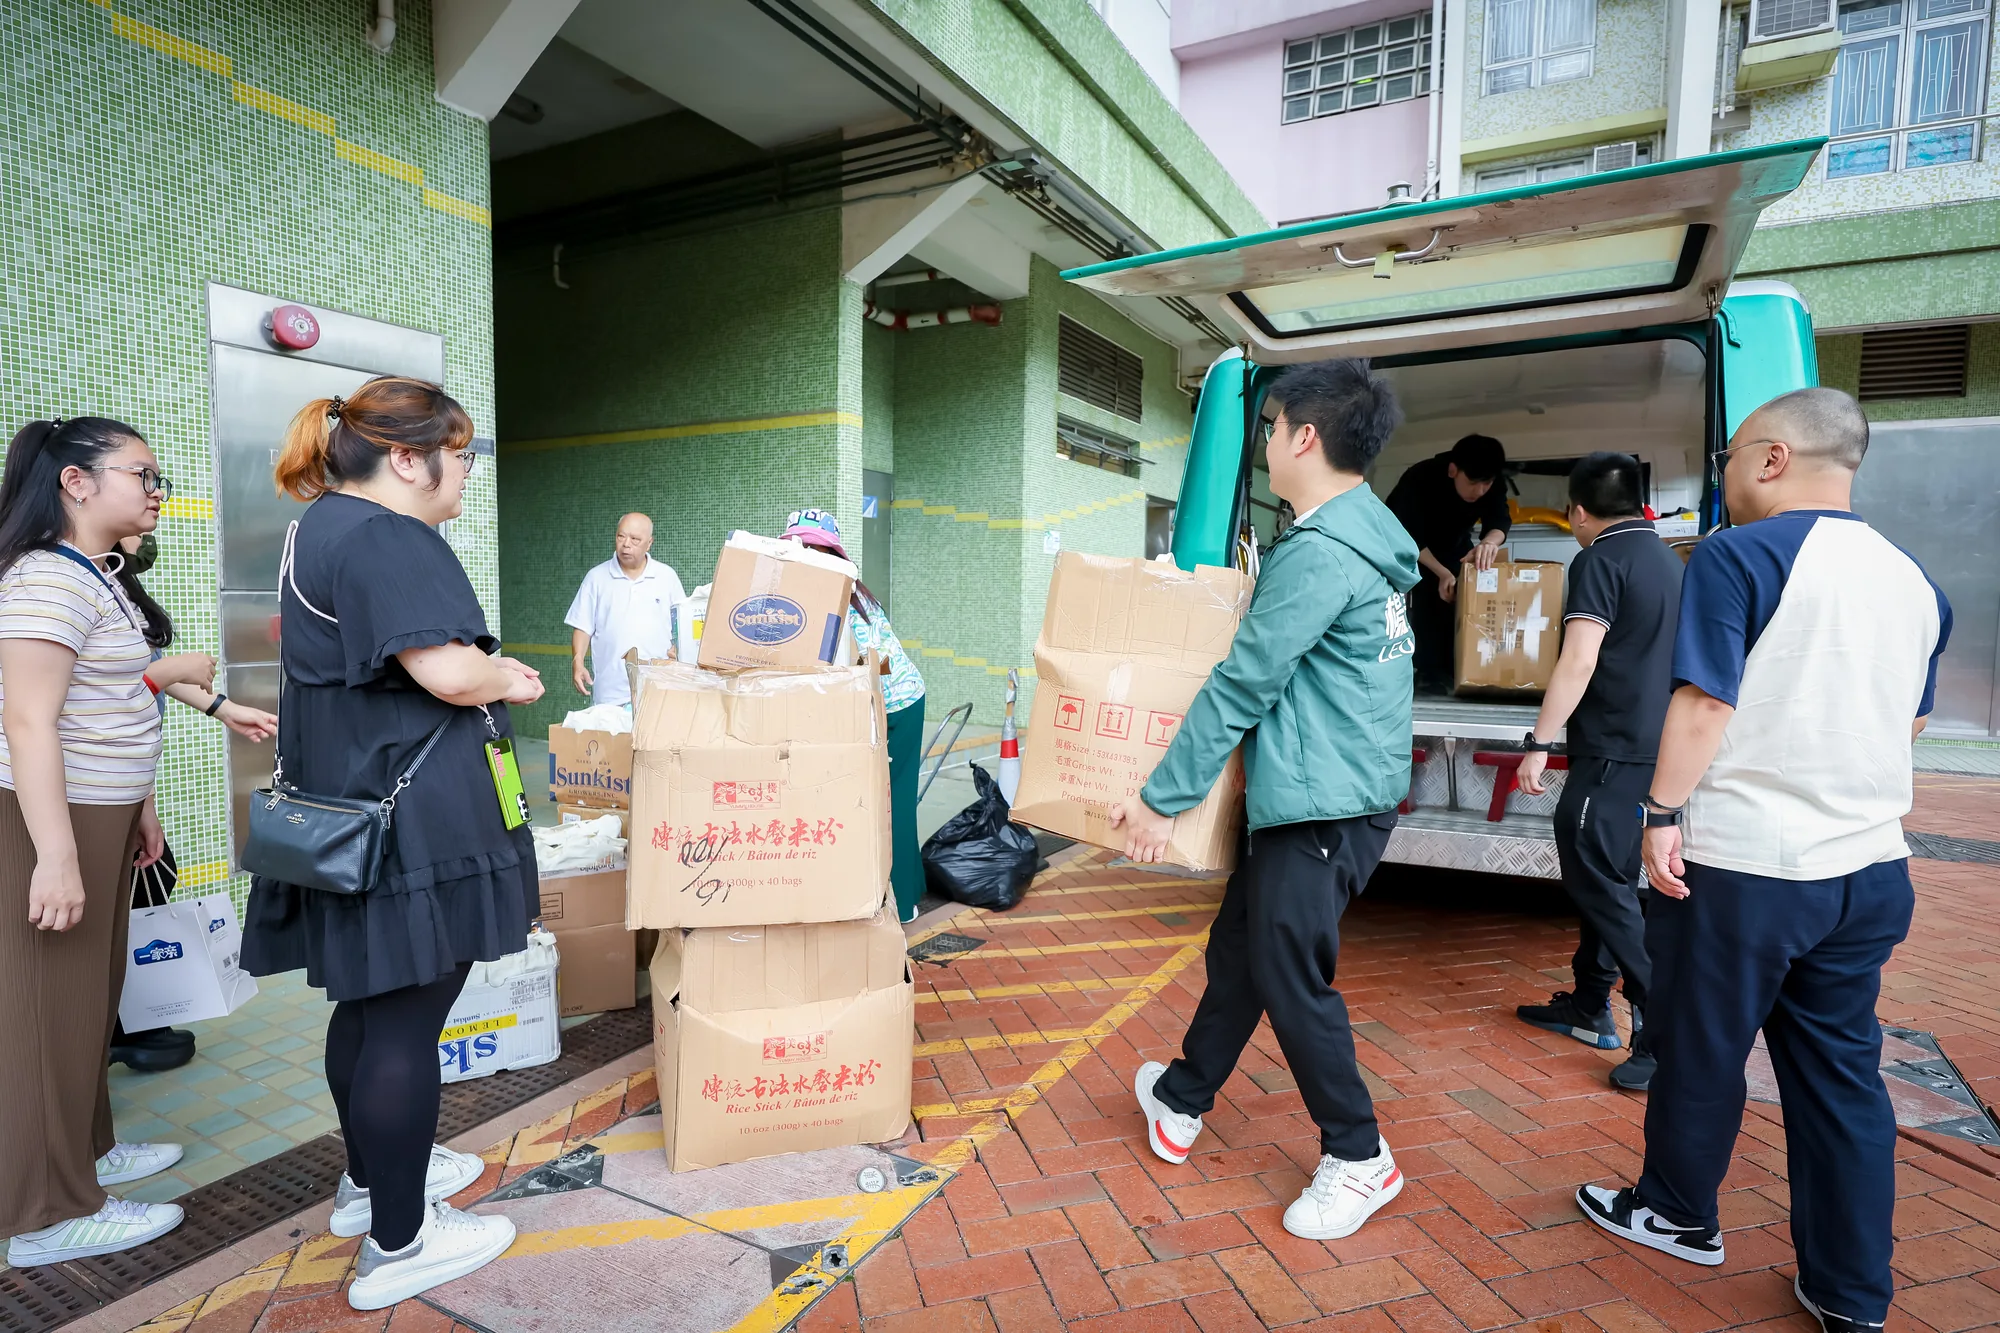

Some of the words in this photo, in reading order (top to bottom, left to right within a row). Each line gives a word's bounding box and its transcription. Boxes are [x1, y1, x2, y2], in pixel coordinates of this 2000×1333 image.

[734, 607, 801, 629] Sunkist
[556, 766, 630, 796] Sunkist
[1060, 790, 1097, 806] Product
[1099, 801, 1110, 809] of
[747, 848, 781, 861] Bâton
[785, 848, 799, 860] de
[802, 848, 817, 859] riz
[767, 876, 779, 886] 40
[781, 875, 803, 888] bags
[725, 1102, 751, 1114] Rice
[753, 1100, 783, 1112] Stick
[793, 1096, 826, 1109] Bâton
[829, 1093, 842, 1104] de
[844, 1091, 858, 1102] riz
[772, 1121, 801, 1133] (300g)
[810, 1119, 823, 1128] 40
[824, 1117, 844, 1129] bags
